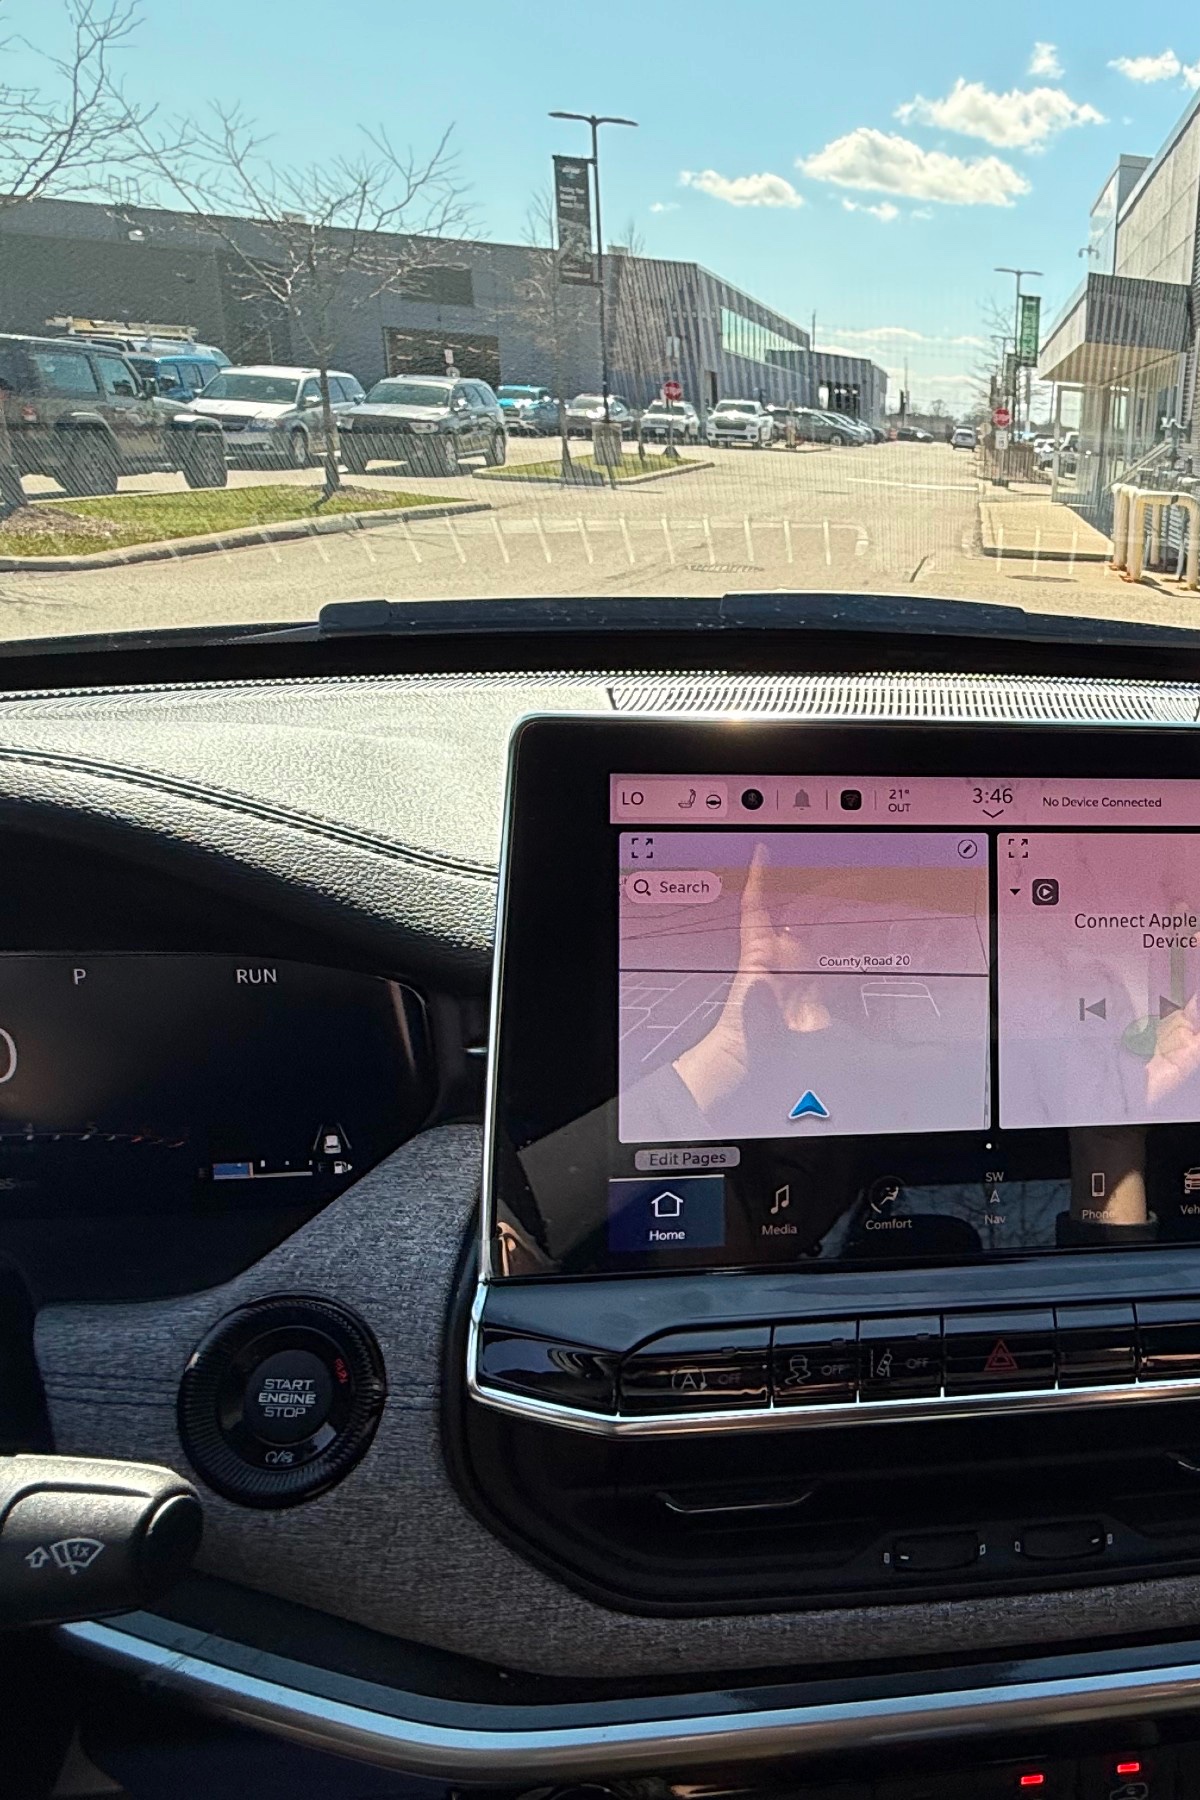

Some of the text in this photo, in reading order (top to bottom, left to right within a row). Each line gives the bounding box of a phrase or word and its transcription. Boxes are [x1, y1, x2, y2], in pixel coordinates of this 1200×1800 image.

[622, 791, 644, 805] LO
[972, 787, 1013, 804] 3:46
[1042, 796, 1162, 808] No Device Connected
[888, 803, 911, 813] OUT
[659, 880, 710, 894] Search
[1074, 912, 1145, 929] Connect
[1148, 912, 1198, 931] Apple
[1142, 932, 1198, 949] Device
[818, 955, 911, 969] County Road 20
[73, 968, 87, 985] P
[236, 968, 278, 984] RUN
[649, 1151, 727, 1167] Edit Pages
[985, 1171, 1005, 1183] SW
[865, 1218, 913, 1231] Comfort
[984, 1213, 1007, 1226] Nav
[649, 1229, 686, 1241] Home
[762, 1223, 798, 1236] Media
[820, 1363, 846, 1376] OFF
[906, 1357, 930, 1369] OFF
[264, 1378, 315, 1391] START
[258, 1392, 317, 1405] ENGINE
[264, 1406, 307, 1418] STOP
